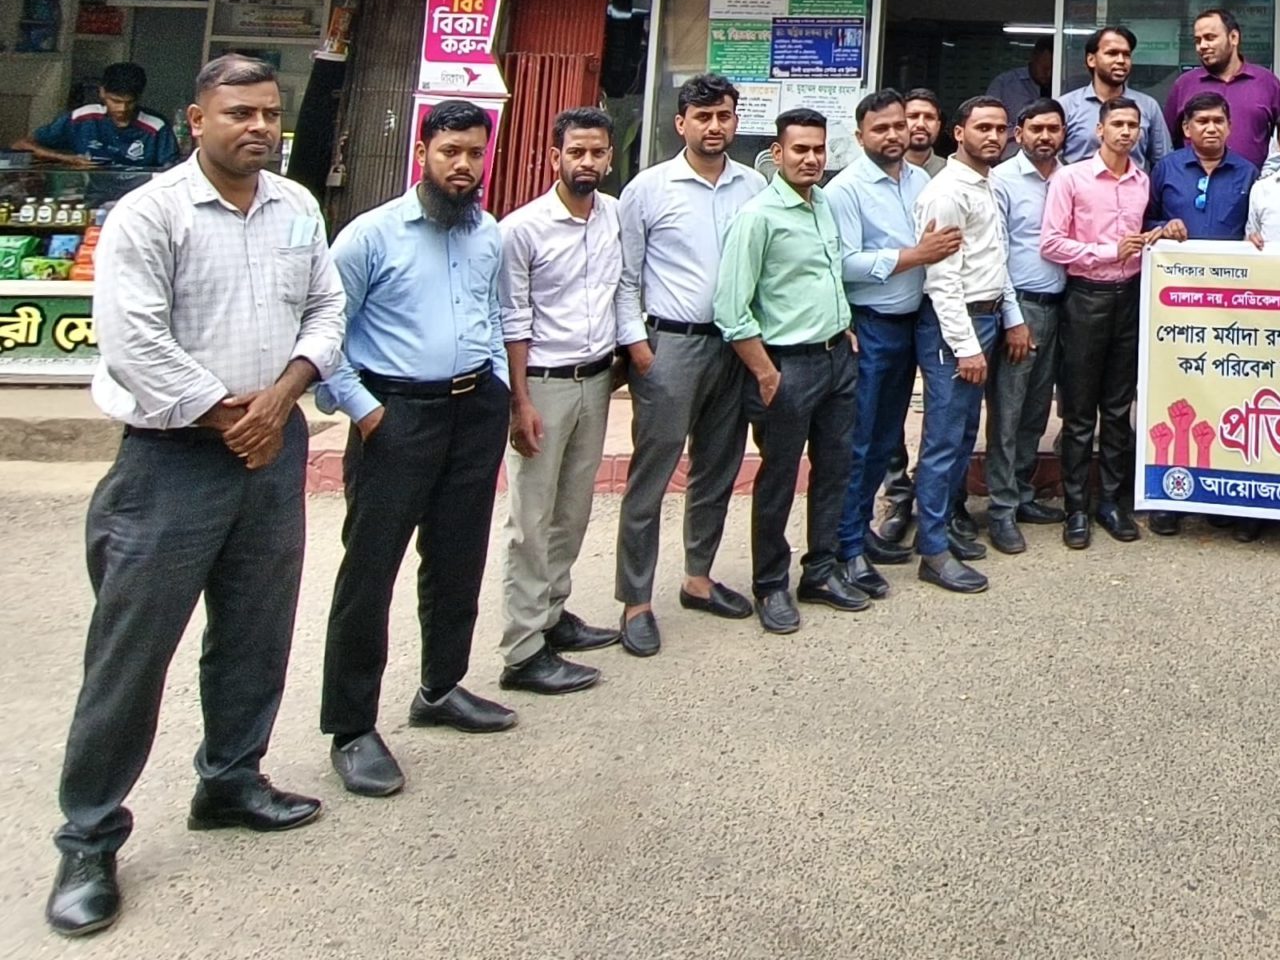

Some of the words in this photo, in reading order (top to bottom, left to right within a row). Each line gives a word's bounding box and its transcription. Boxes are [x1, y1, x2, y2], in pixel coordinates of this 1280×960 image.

[1210, 267, 1248, 279] আদায়ে
[1169, 292, 1204, 304] দালাল
[1231, 291, 1280, 307] মেডিকেল
[1156, 324, 1207, 343] পেশার
[1212, 321, 1260, 346] মর্যাদা
[1177, 351, 1207, 377] কর্ম
[1211, 352, 1275, 380] পরিবেশ
